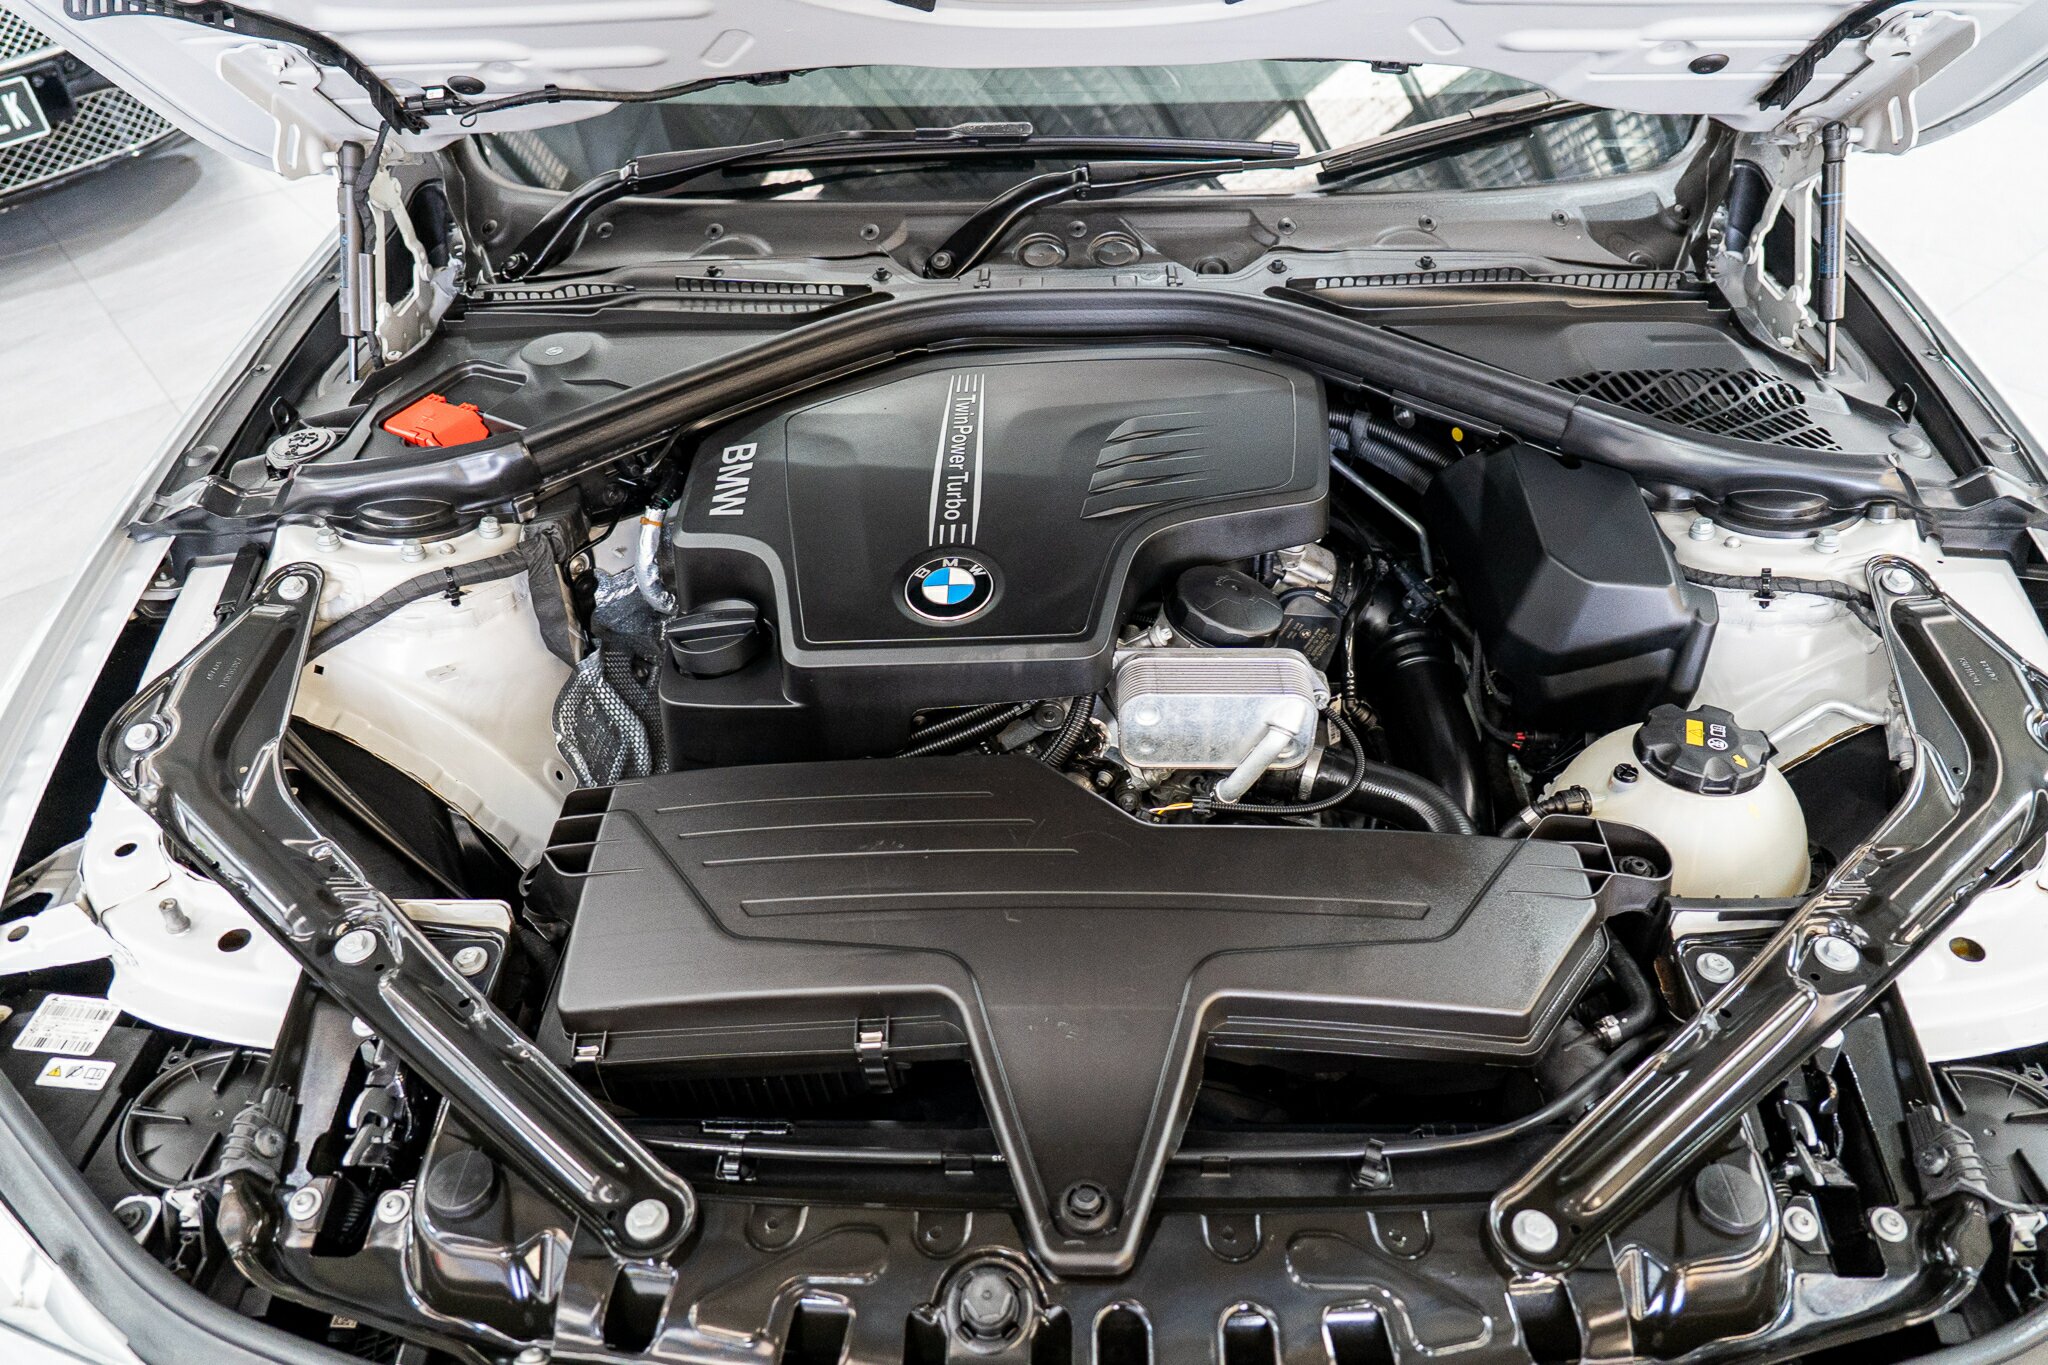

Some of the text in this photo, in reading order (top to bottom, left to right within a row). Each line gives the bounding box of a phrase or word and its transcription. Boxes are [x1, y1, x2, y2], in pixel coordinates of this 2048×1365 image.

[708, 442, 758, 516] BMW
[944, 471, 970, 521] Turbo
[914, 558, 987, 579] BMW
